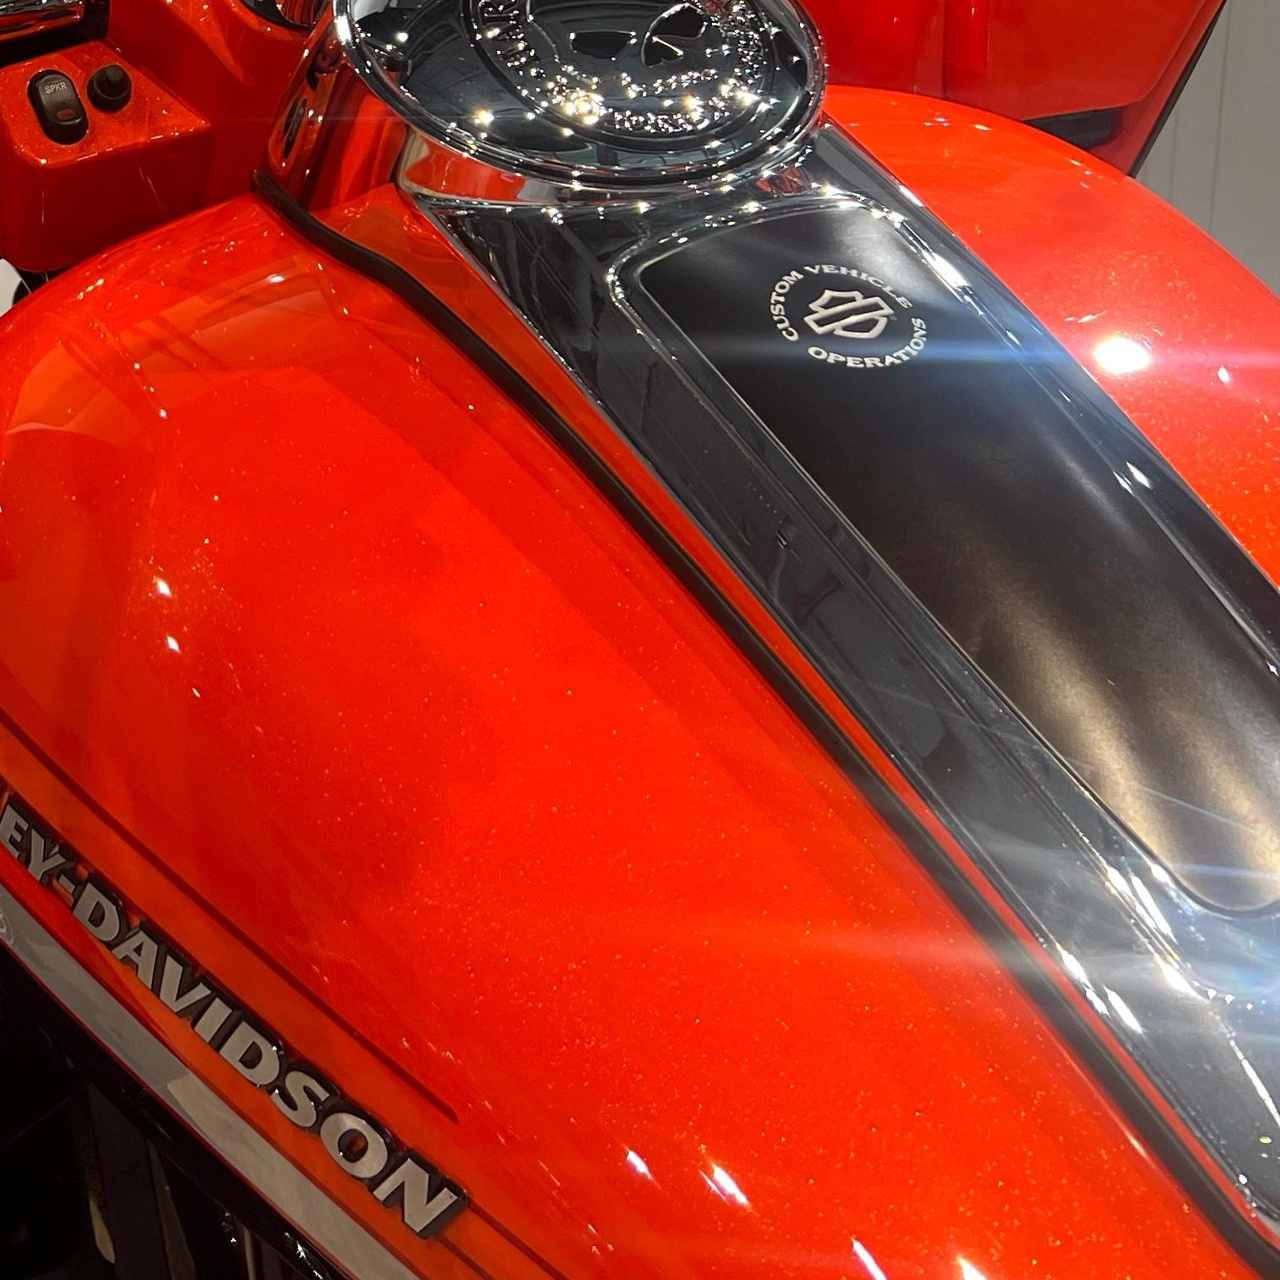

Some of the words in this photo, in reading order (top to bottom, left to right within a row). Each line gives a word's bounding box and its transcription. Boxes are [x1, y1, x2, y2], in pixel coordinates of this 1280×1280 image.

[44, 81, 68, 94] SPKR
[770, 270, 805, 342] CUSTOM
[803, 263, 914, 310] VEHICLE
[807, 317, 929, 368] OPERATIONS
